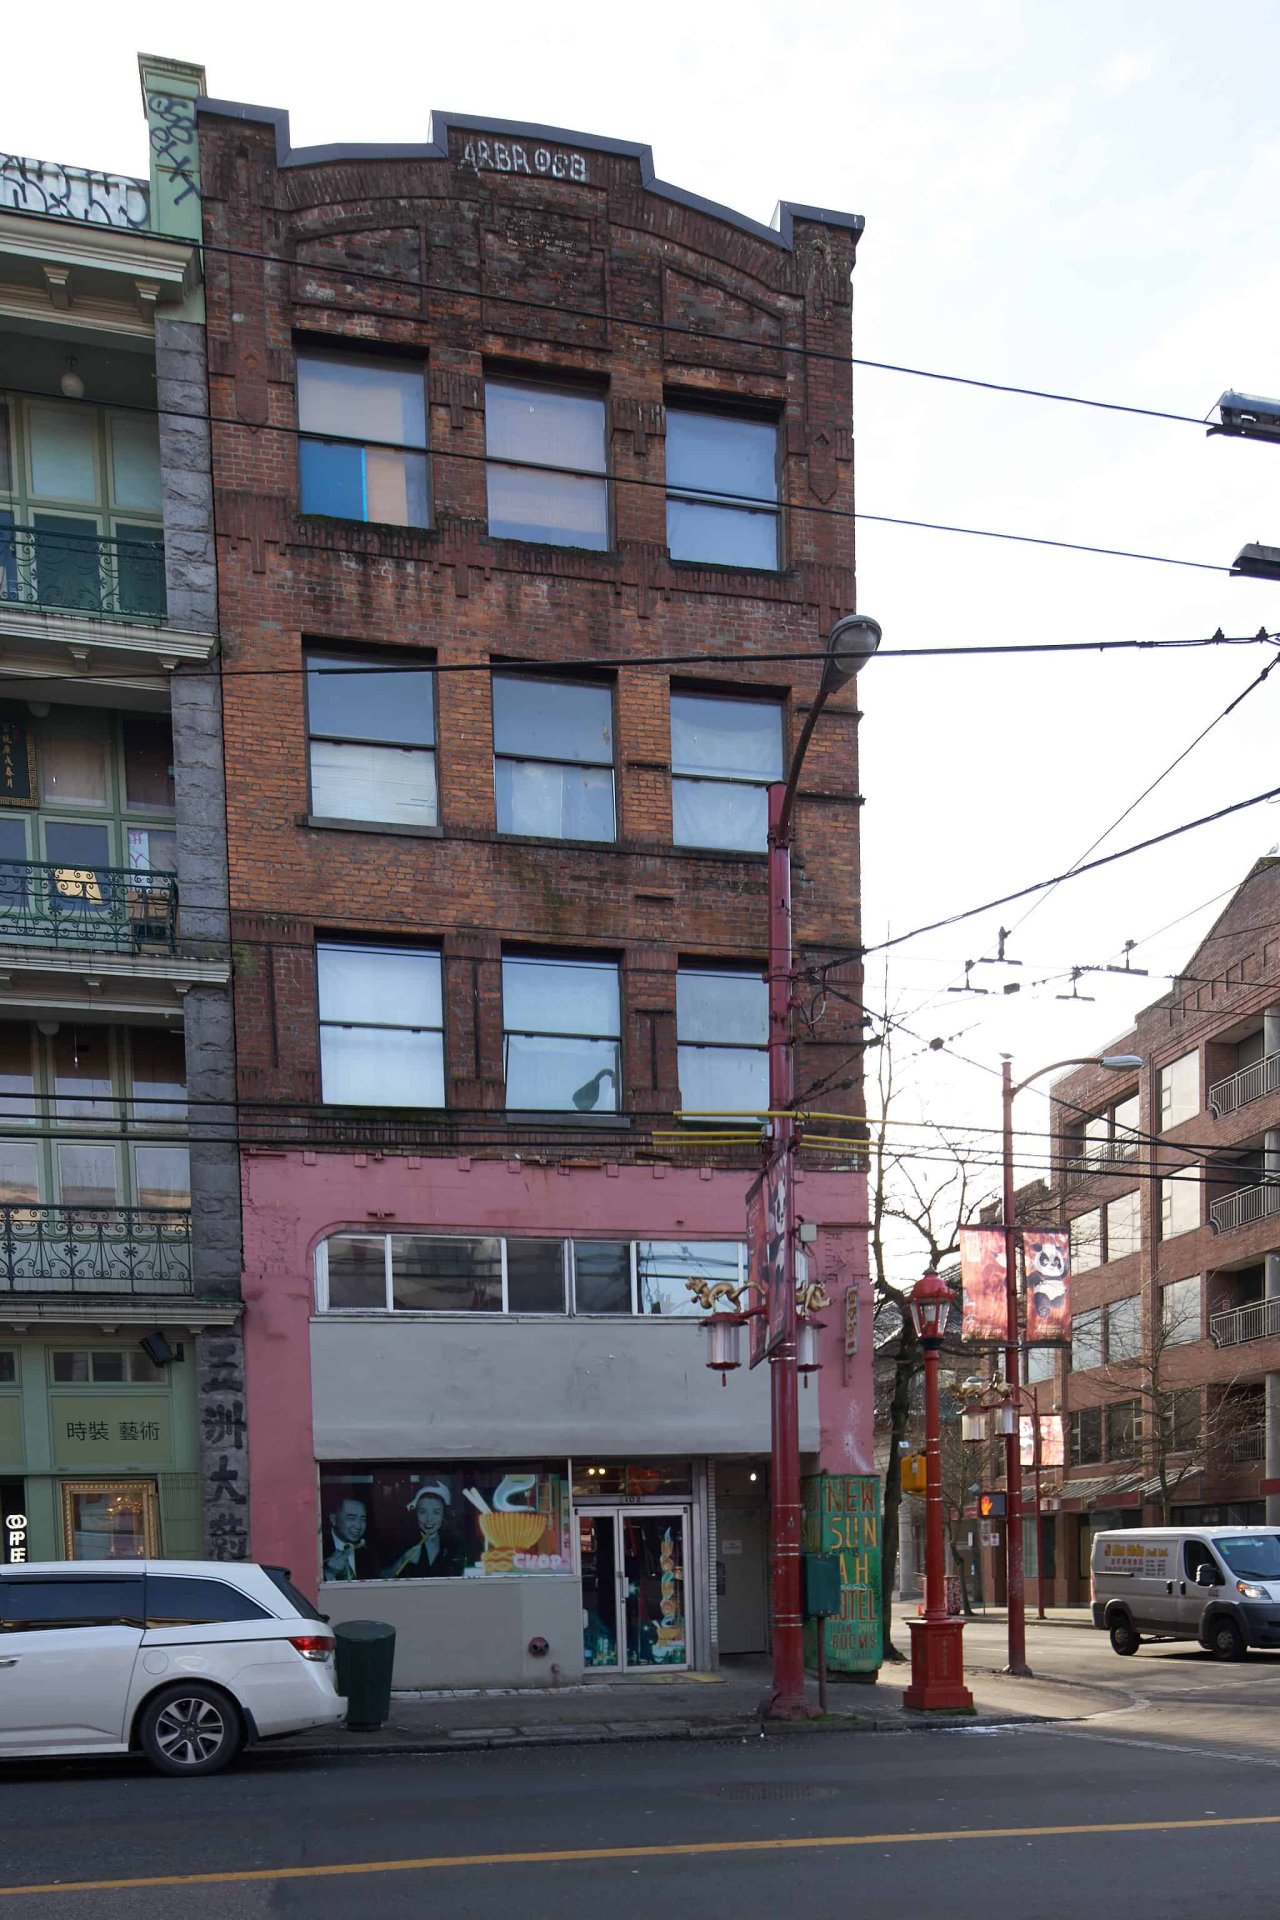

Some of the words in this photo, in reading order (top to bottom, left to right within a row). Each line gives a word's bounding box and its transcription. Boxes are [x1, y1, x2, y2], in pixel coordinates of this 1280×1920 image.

[66, 1421, 110, 1441] 時裝
[119, 1421, 160, 1441] 藝術
[826, 1480, 875, 1513] NEW
[6, 1514, 27, 1562] OPE
[829, 1516, 878, 1550] SUN
[830, 1589, 878, 1621] OTEL
[832, 1633, 877, 1650] ROOMS
